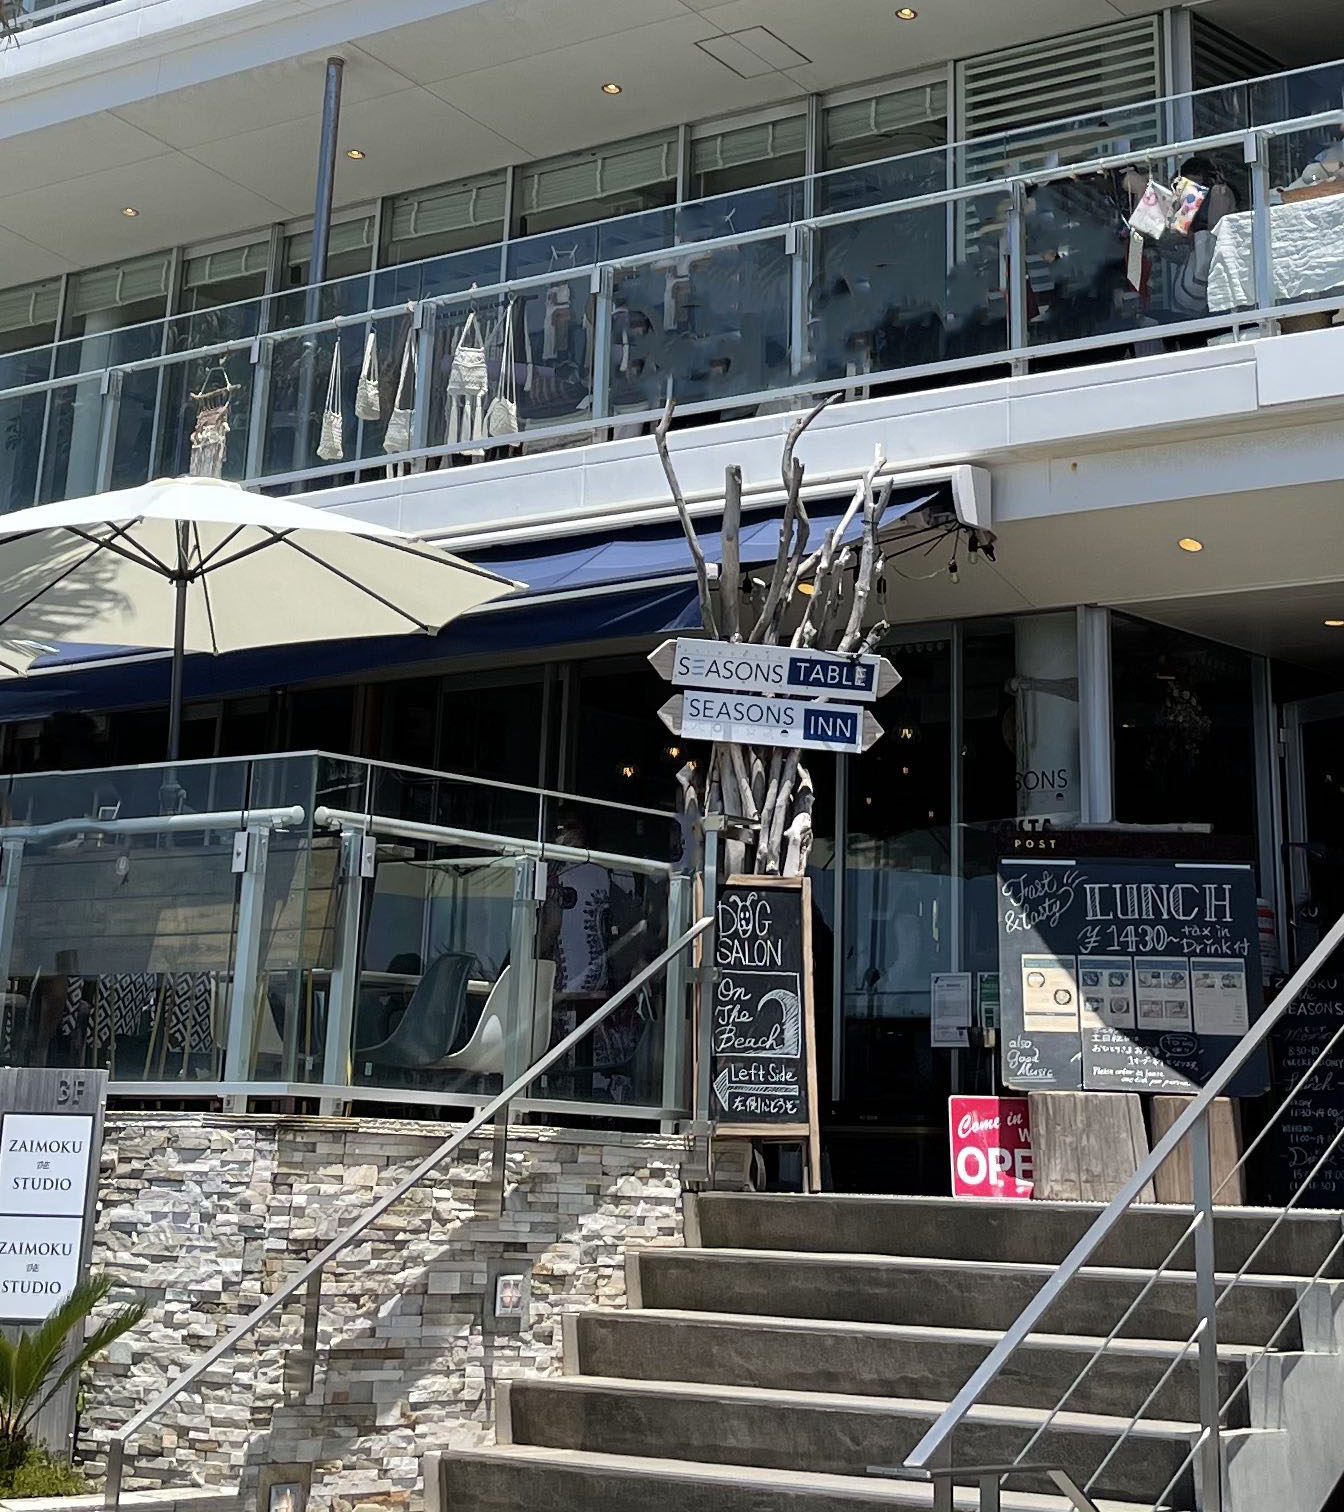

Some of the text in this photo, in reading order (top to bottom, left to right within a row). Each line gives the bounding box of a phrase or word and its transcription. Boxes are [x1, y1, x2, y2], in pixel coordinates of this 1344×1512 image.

[678, 656, 867, 687] SEASONS TABLE
[688, 698, 853, 738] SEASONS INN
[1014, 839, 1057, 849] POST
[1083, 883, 1234, 922] LUNCH
[716, 938, 782, 966] SALON
[717, 978, 752, 1001] On
[714, 1004, 754, 1026] The
[1286, 1002, 1344, 1016] EASONS
[714, 1023, 783, 1052] Beach
[731, 1063, 798, 1082] Left Side
[957, 1114, 1001, 1139] Come
[1007, 1111, 1023, 1127] in
[8, 1139, 83, 1154] ZAIMOKU
[956, 1146, 1034, 1186] OPE
[12, 1176, 72, 1191] STUDIO
[1, 1280, 62, 1295] STUDIO
